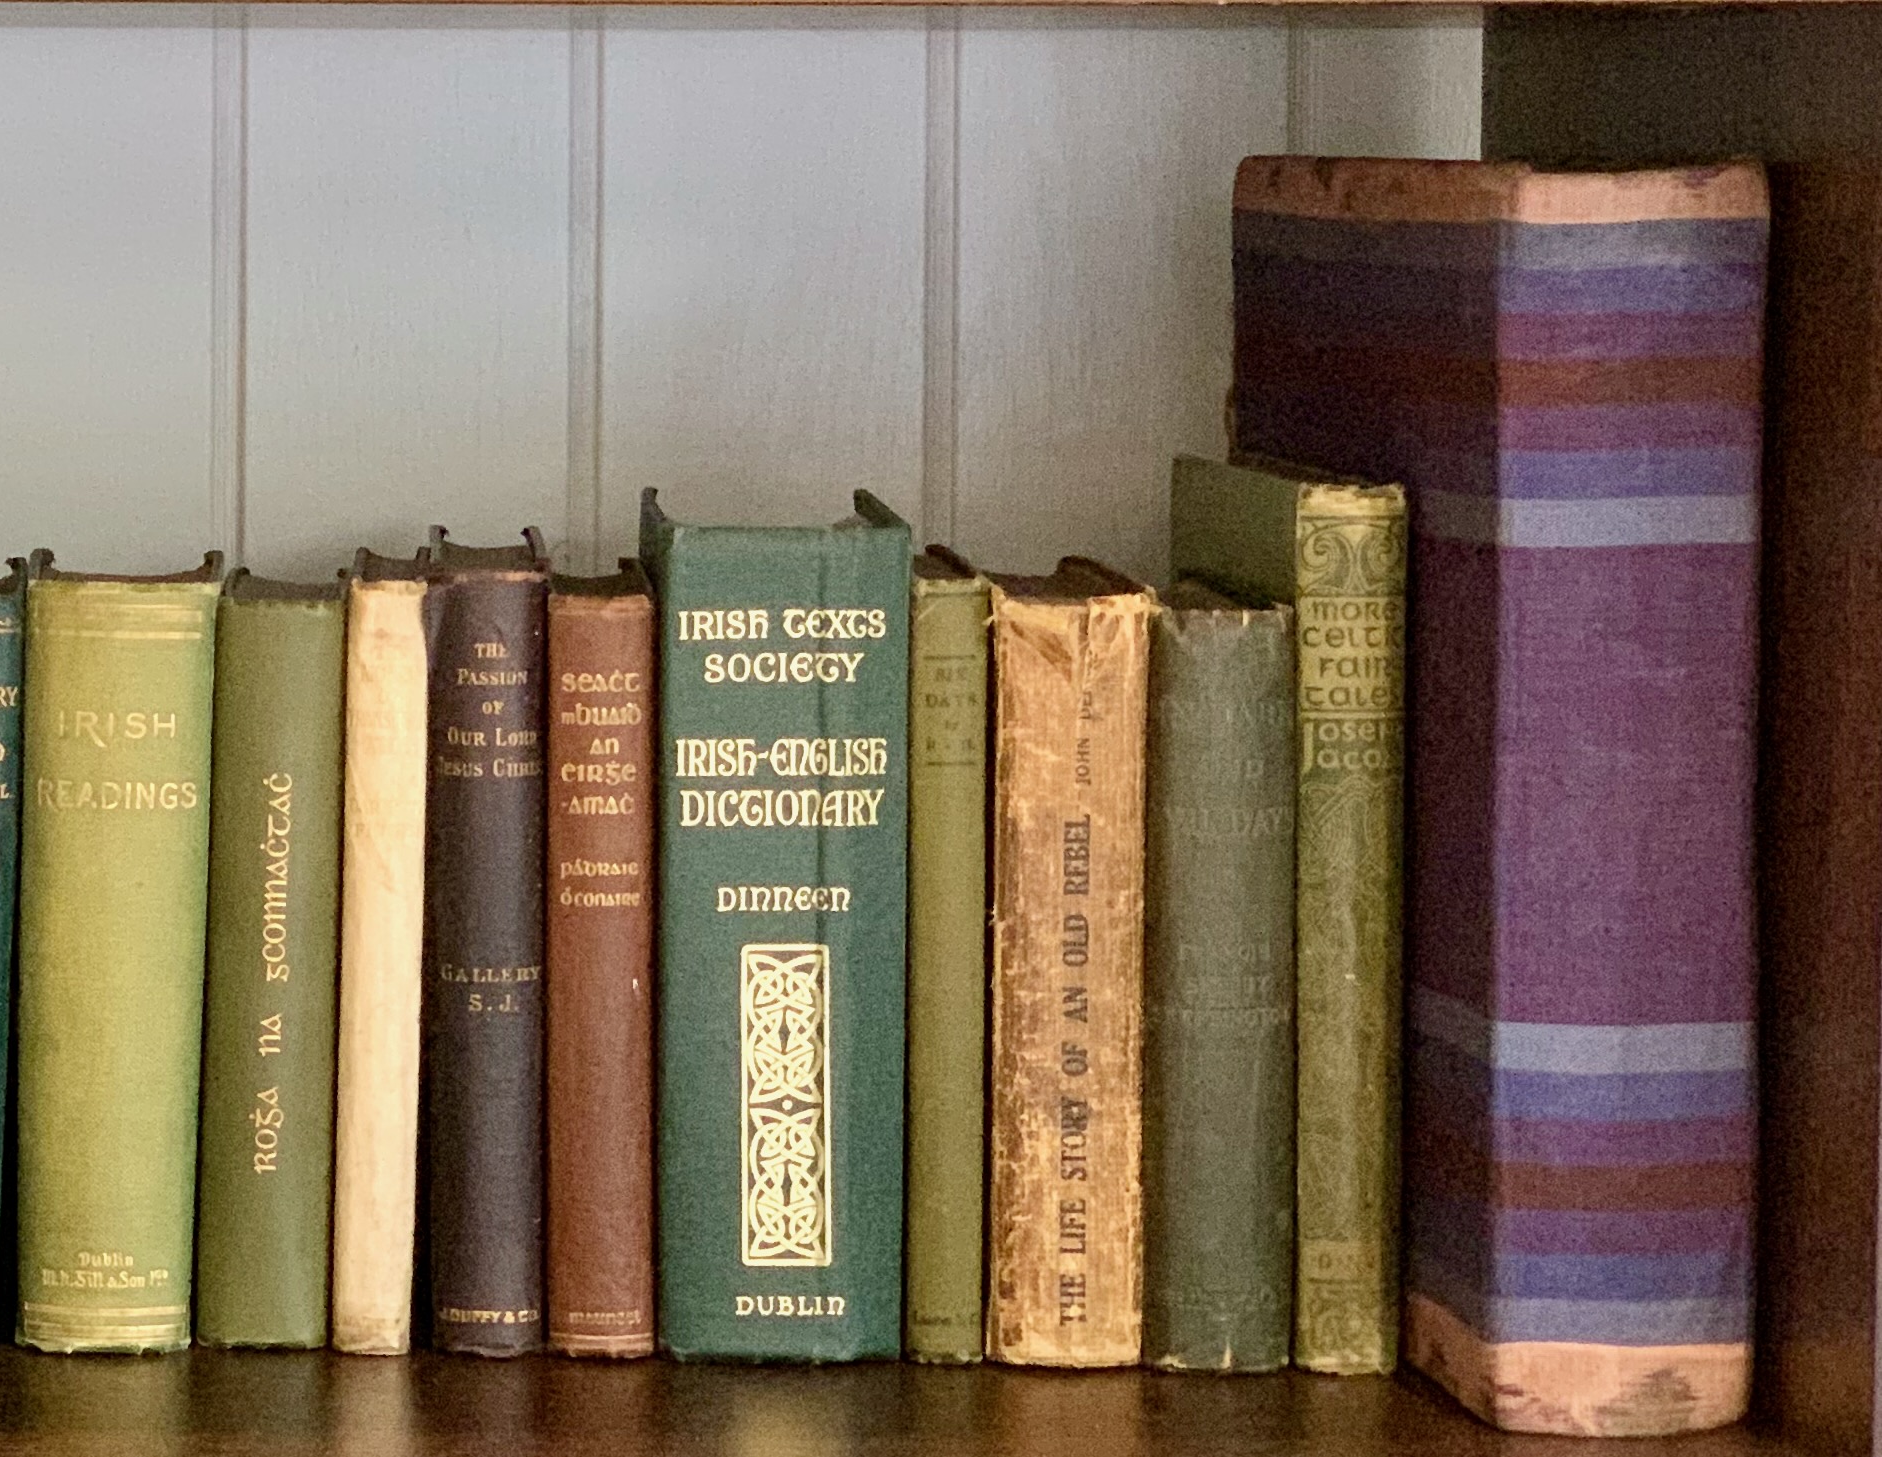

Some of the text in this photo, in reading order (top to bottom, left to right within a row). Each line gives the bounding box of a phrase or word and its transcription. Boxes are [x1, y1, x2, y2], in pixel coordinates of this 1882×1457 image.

[678, 608, 887, 641] IRISH TEXTS
[474, 642, 508, 659] THE
[704, 652, 865, 683] SOCIETY
[59, 710, 177, 748] IRISH
[675, 737, 888, 777] IRISH-ENGLISH
[37, 777, 198, 813] READINGS
[679, 788, 885, 828] DICTIONARY
[716, 885, 851, 912] DINNEEN
[1060, 812, 1091, 1326] THE LIFE STORY OF AN OLD REBEL
[78, 1251, 134, 1267] Dublin
[735, 1295, 846, 1316] DUBLIN
